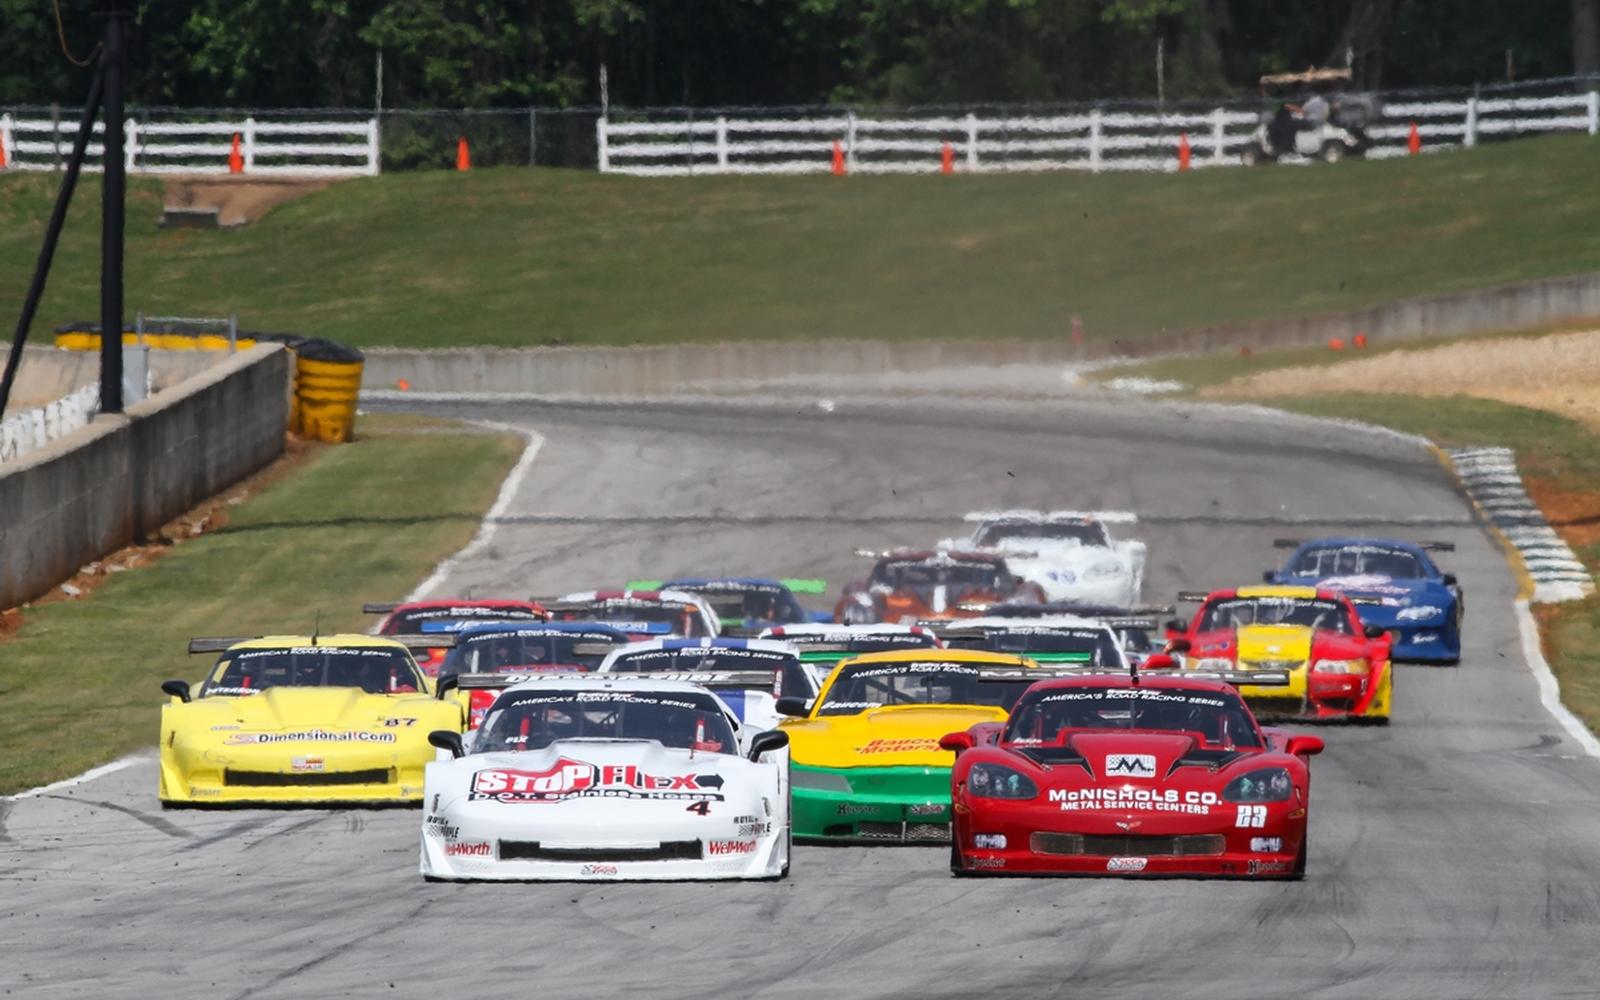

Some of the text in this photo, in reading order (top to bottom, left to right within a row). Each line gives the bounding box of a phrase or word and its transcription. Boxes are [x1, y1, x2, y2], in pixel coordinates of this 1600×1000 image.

[851, 667, 907, 679] AMERICA'S
[511, 696, 573, 707] AMERICA'S
[613, 696, 657, 705] RACING
[660, 699, 697, 709] SERIES
[1041, 693, 1103, 702] AMERICA'S
[1141, 694, 1186, 702] RACING
[1188, 697, 1225, 707] SERIES
[384, 717, 417, 727] 87
[476, 764, 591, 793] STOP
[1185, 791, 1222, 805] CO.
[686, 800, 712, 816] 4
[1060, 800, 1209, 814] METAL SERVICE CENTERS
[1235, 804, 1268, 828] 23
